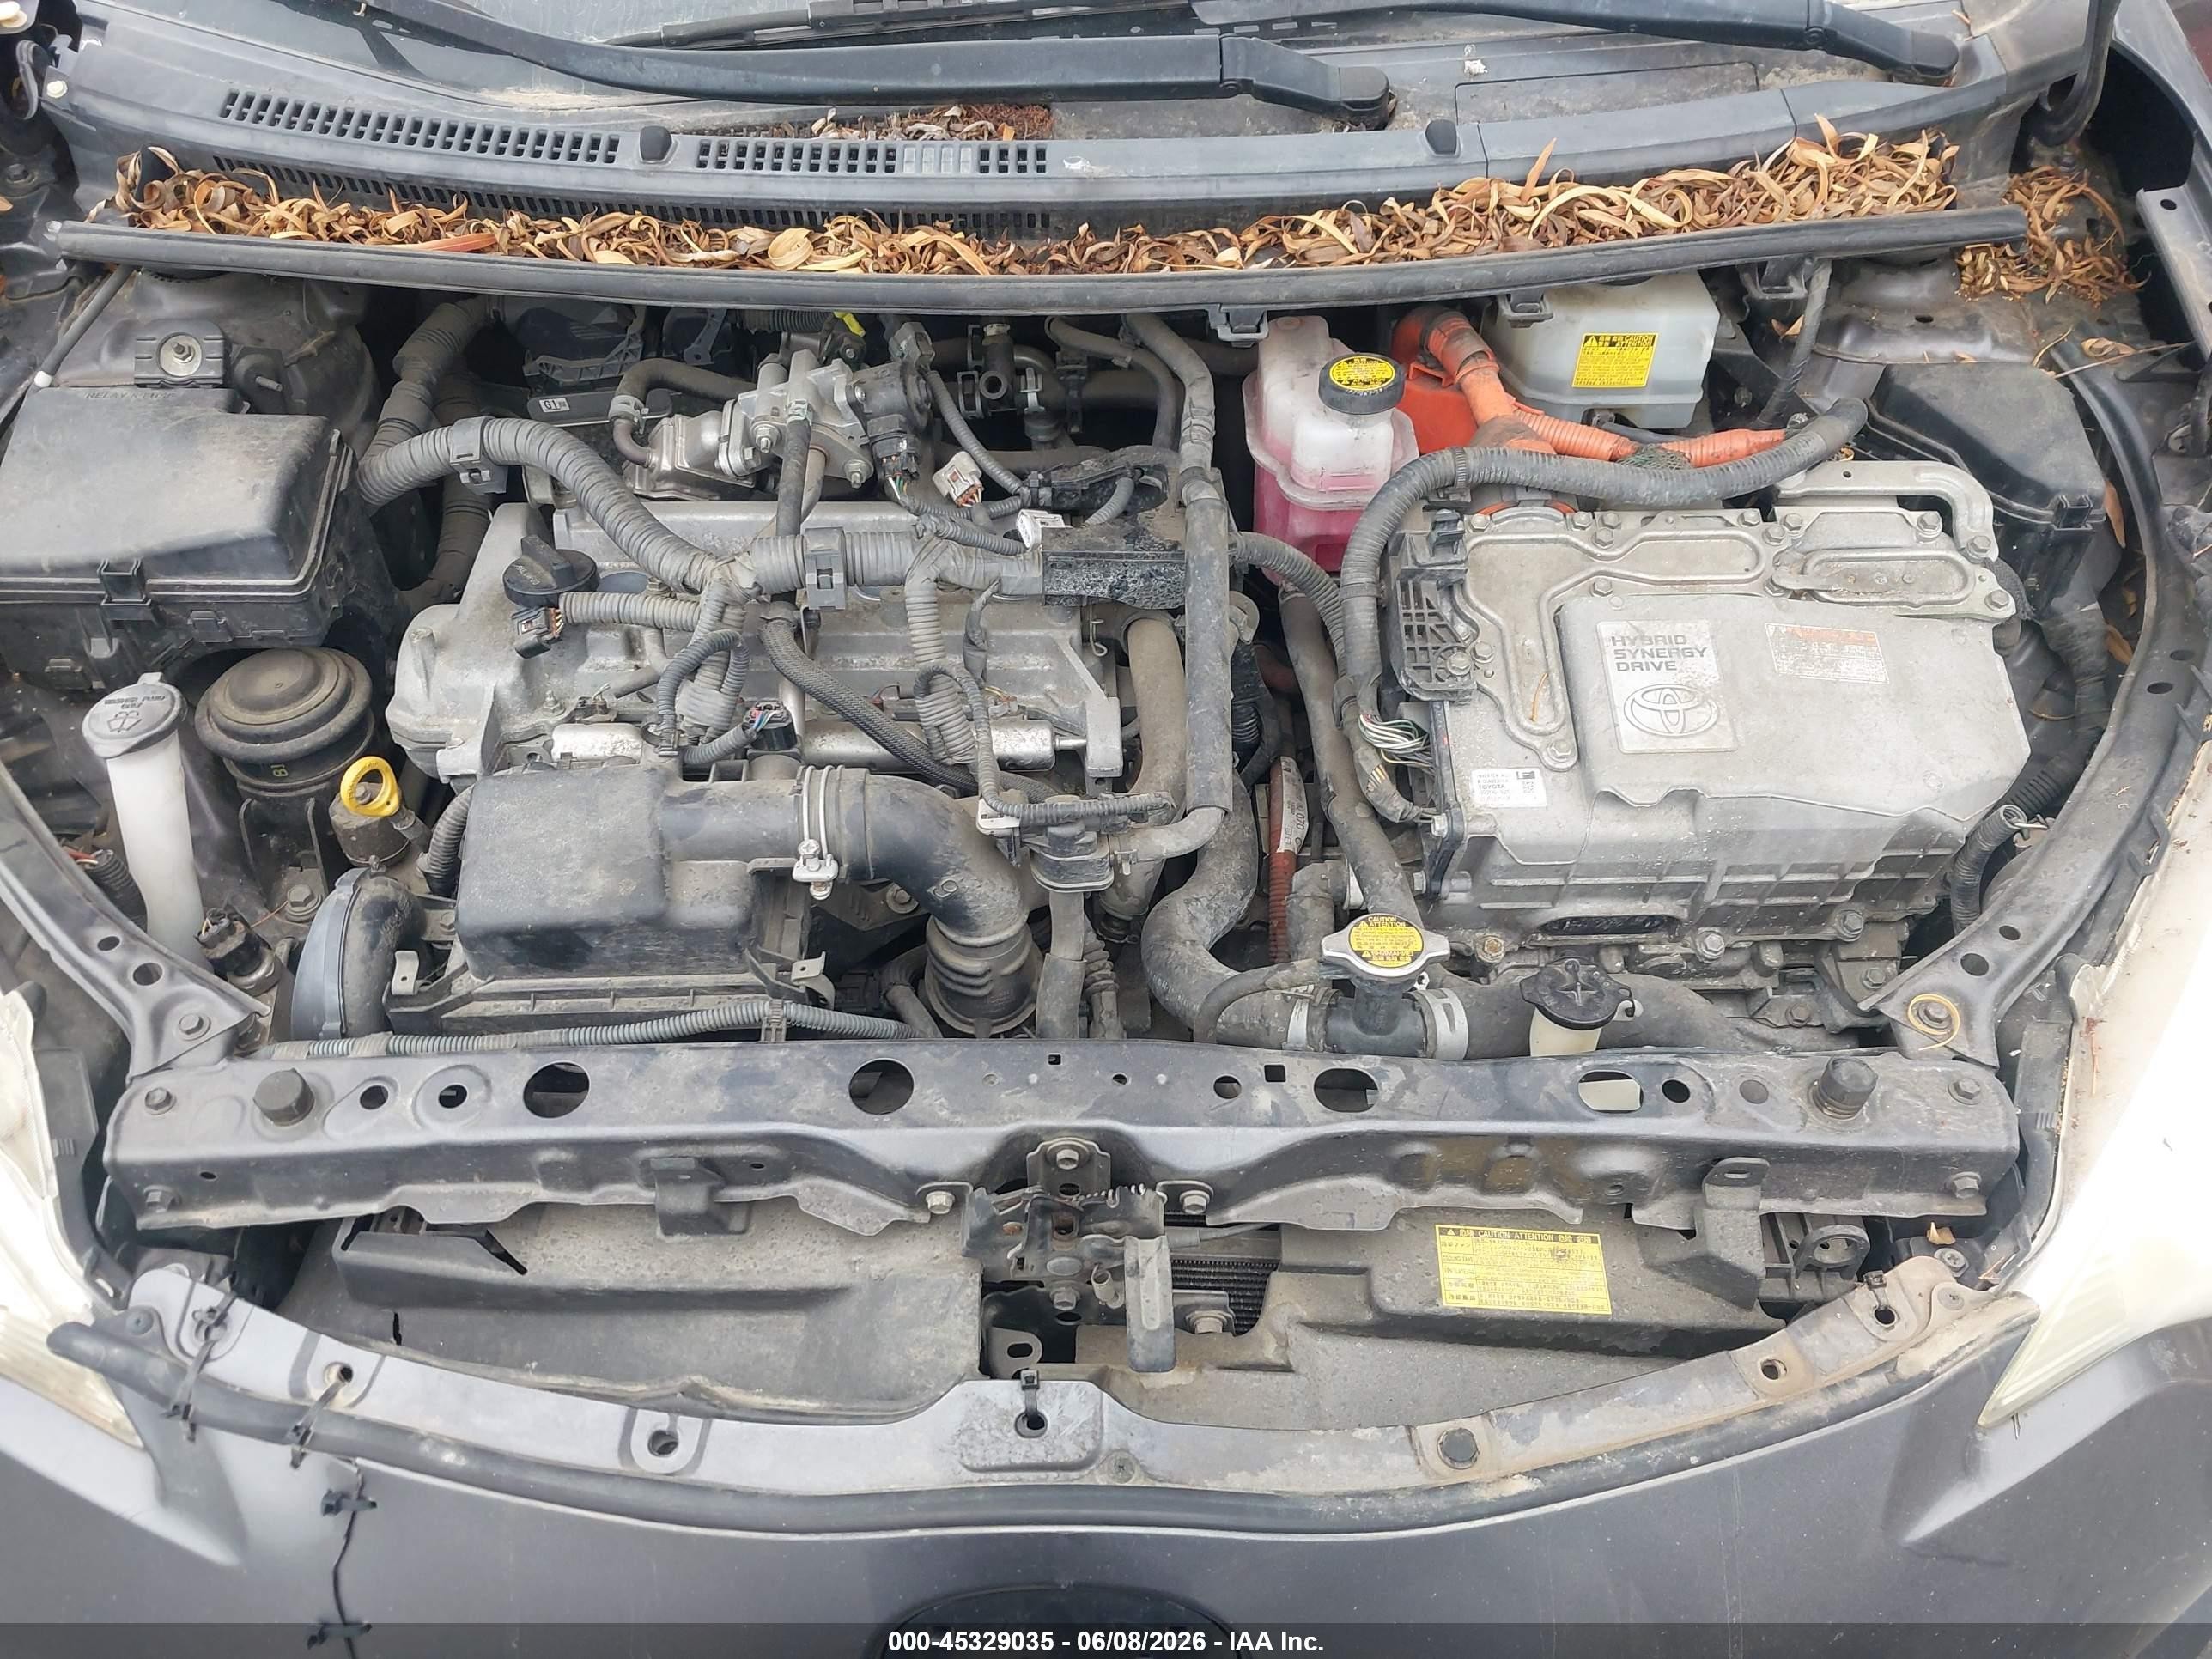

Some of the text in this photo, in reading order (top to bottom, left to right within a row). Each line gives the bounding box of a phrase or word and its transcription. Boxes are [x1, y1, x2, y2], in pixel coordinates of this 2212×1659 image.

[1611, 635, 1687, 646] HYBRID
[1613, 647, 1707, 659] SYNERGY
[1615, 660, 1677, 672] DRIVE
[1478, 1231, 1510, 1239] CAUTION
[1514, 1233, 1553, 1242] ATTENTION
